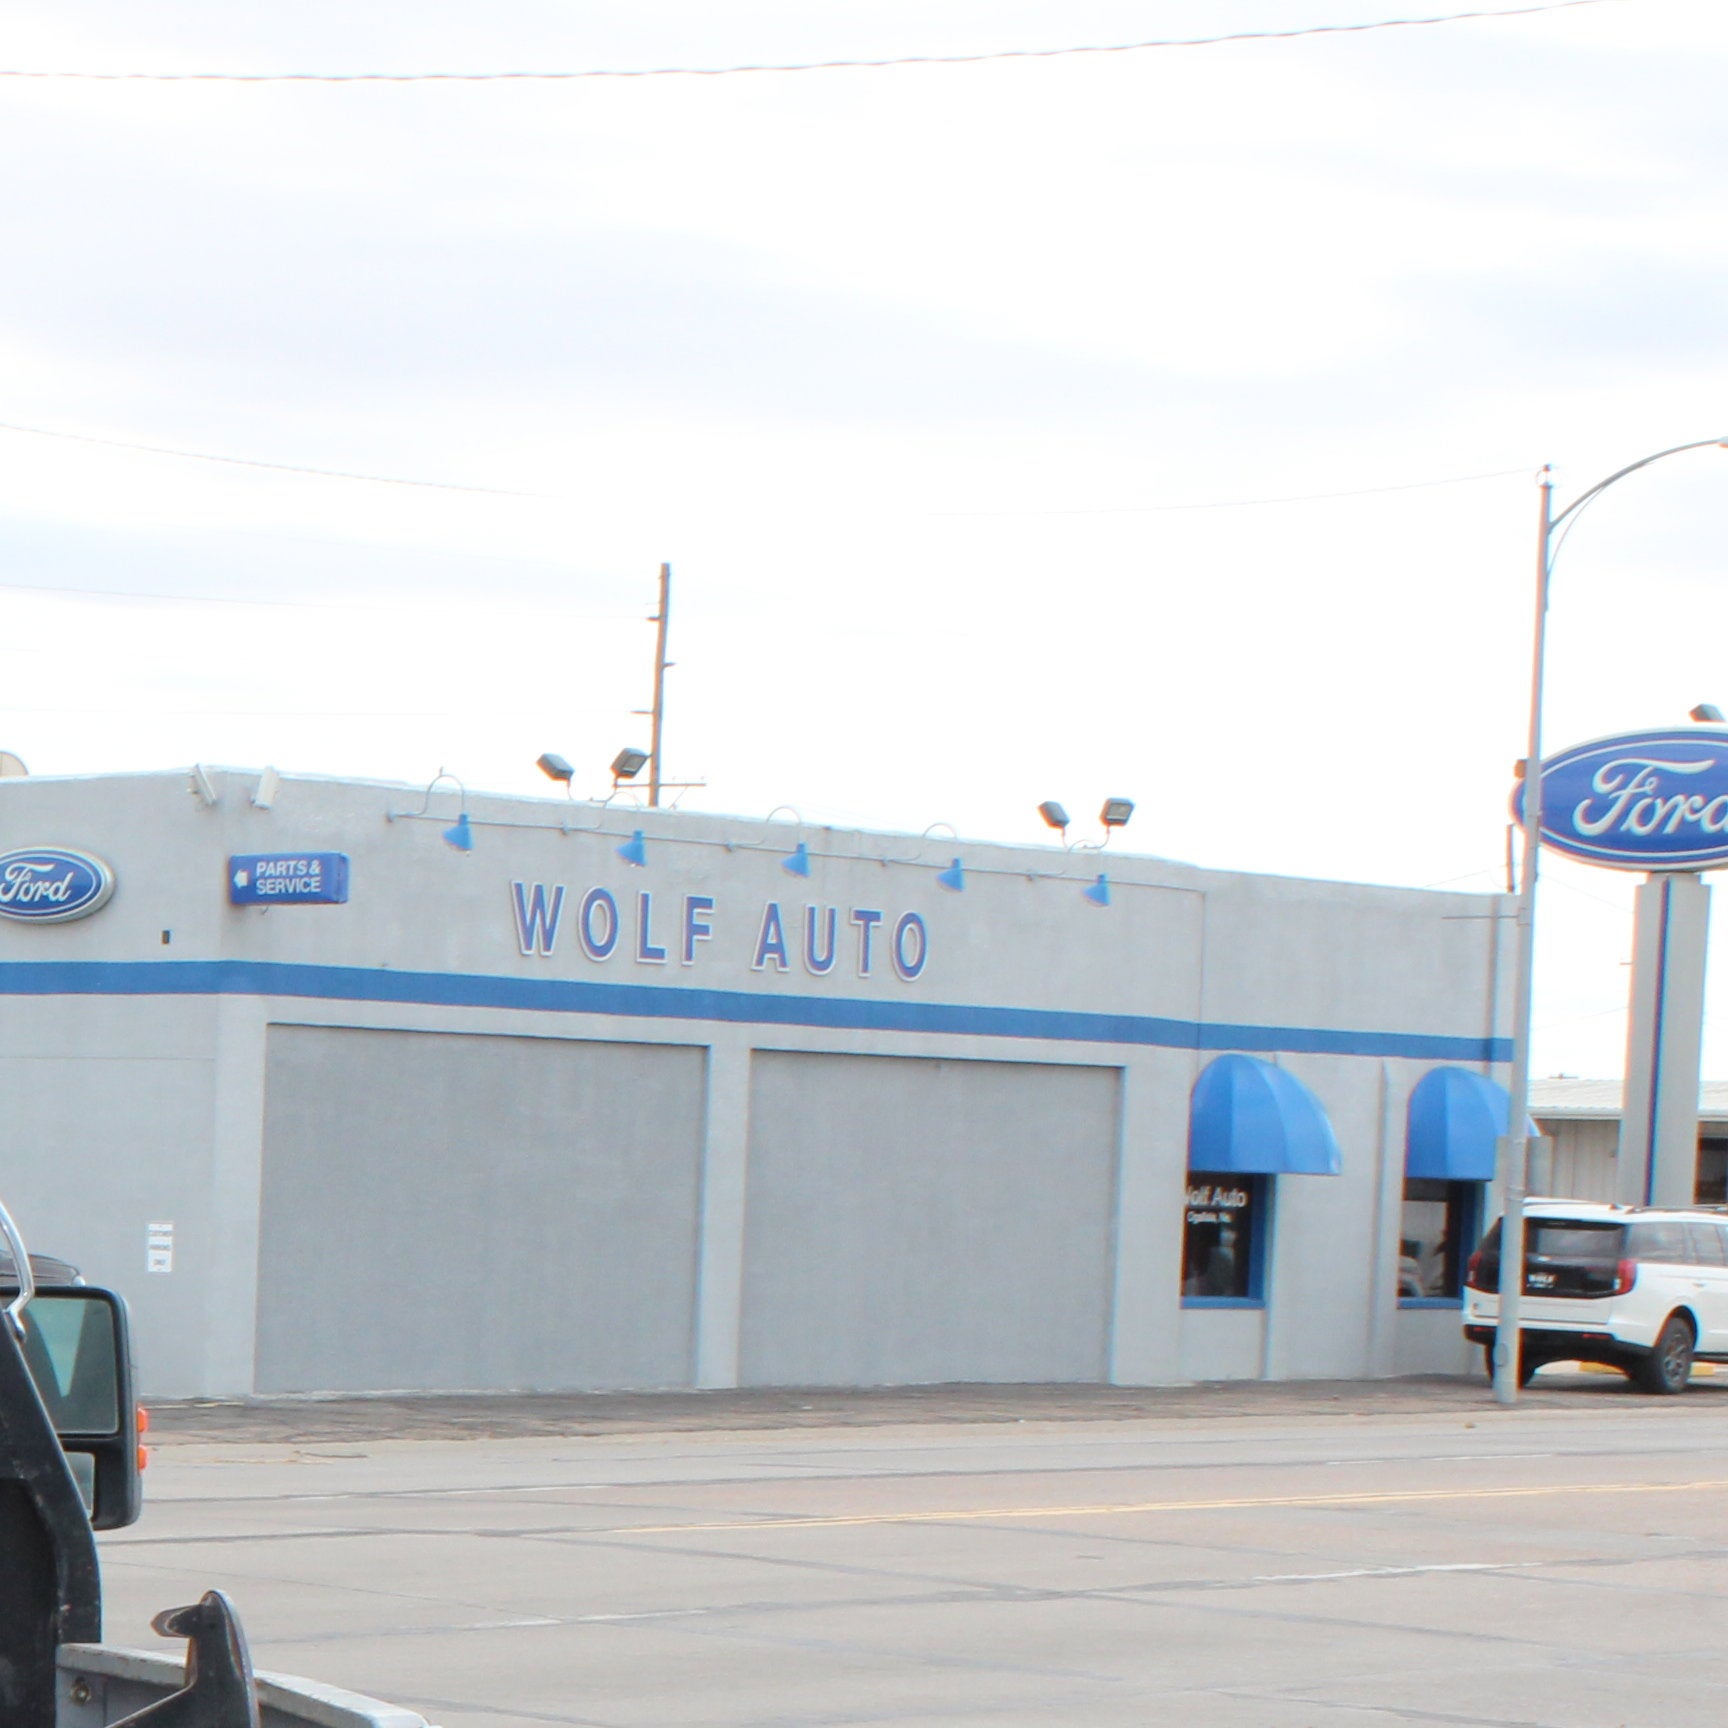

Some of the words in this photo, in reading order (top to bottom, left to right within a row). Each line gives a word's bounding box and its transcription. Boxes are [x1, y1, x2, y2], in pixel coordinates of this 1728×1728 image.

[255, 860, 307, 877] PARTS
[307, 860, 322, 875] &
[255, 876, 322, 895] SERVICE
[511, 880, 716, 966] WOLF
[750, 900, 928, 983] AUTO
